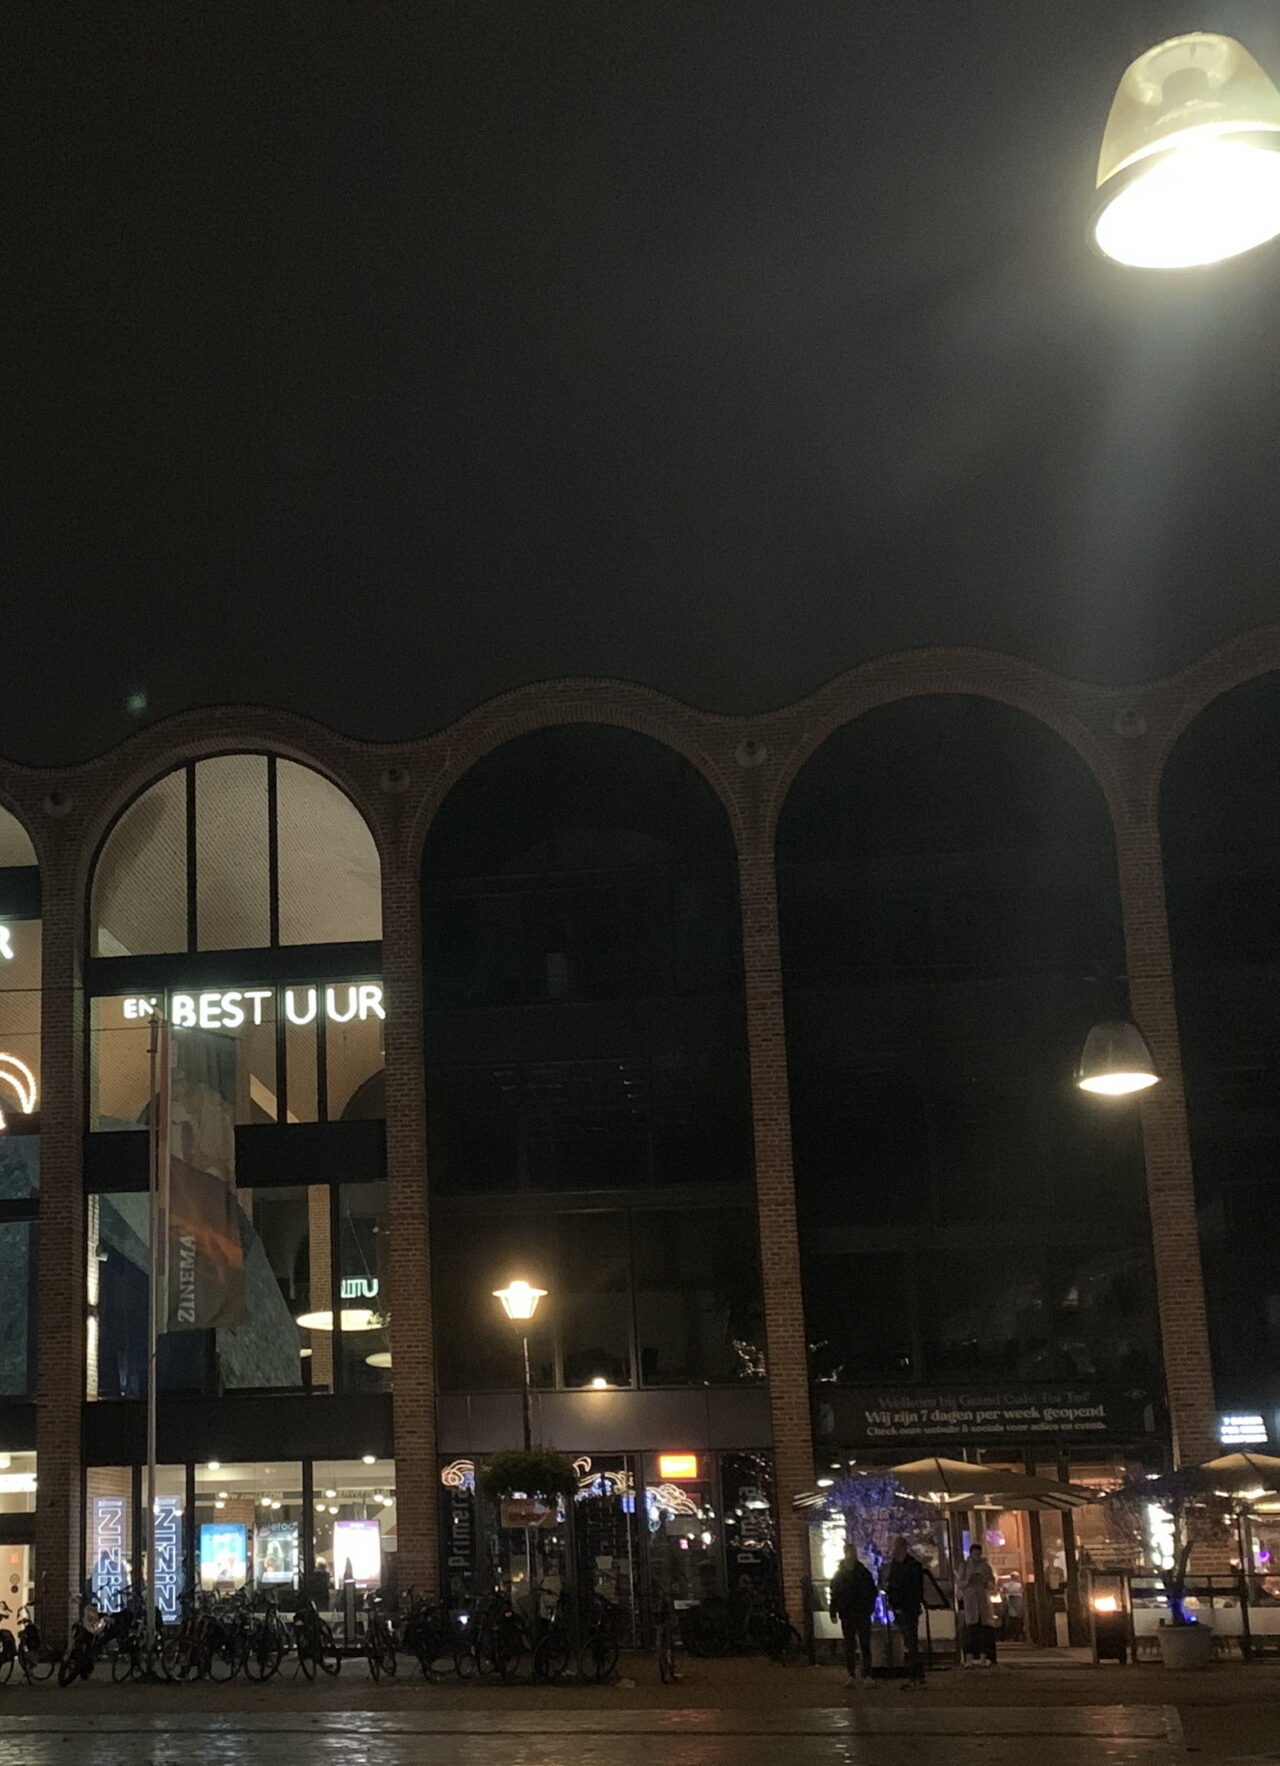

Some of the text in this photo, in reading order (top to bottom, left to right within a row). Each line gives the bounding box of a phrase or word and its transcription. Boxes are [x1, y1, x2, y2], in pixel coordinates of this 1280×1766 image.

[123, 986, 386, 1029] EN BESTUUR
[176, 1235, 195, 1324] ZINEMA
[865, 1404, 1105, 1426] Wij zijn 7 dagen per week geopend
[865, 1426, 898, 1436] Check
[1006, 1424, 1030, 1432] voor
